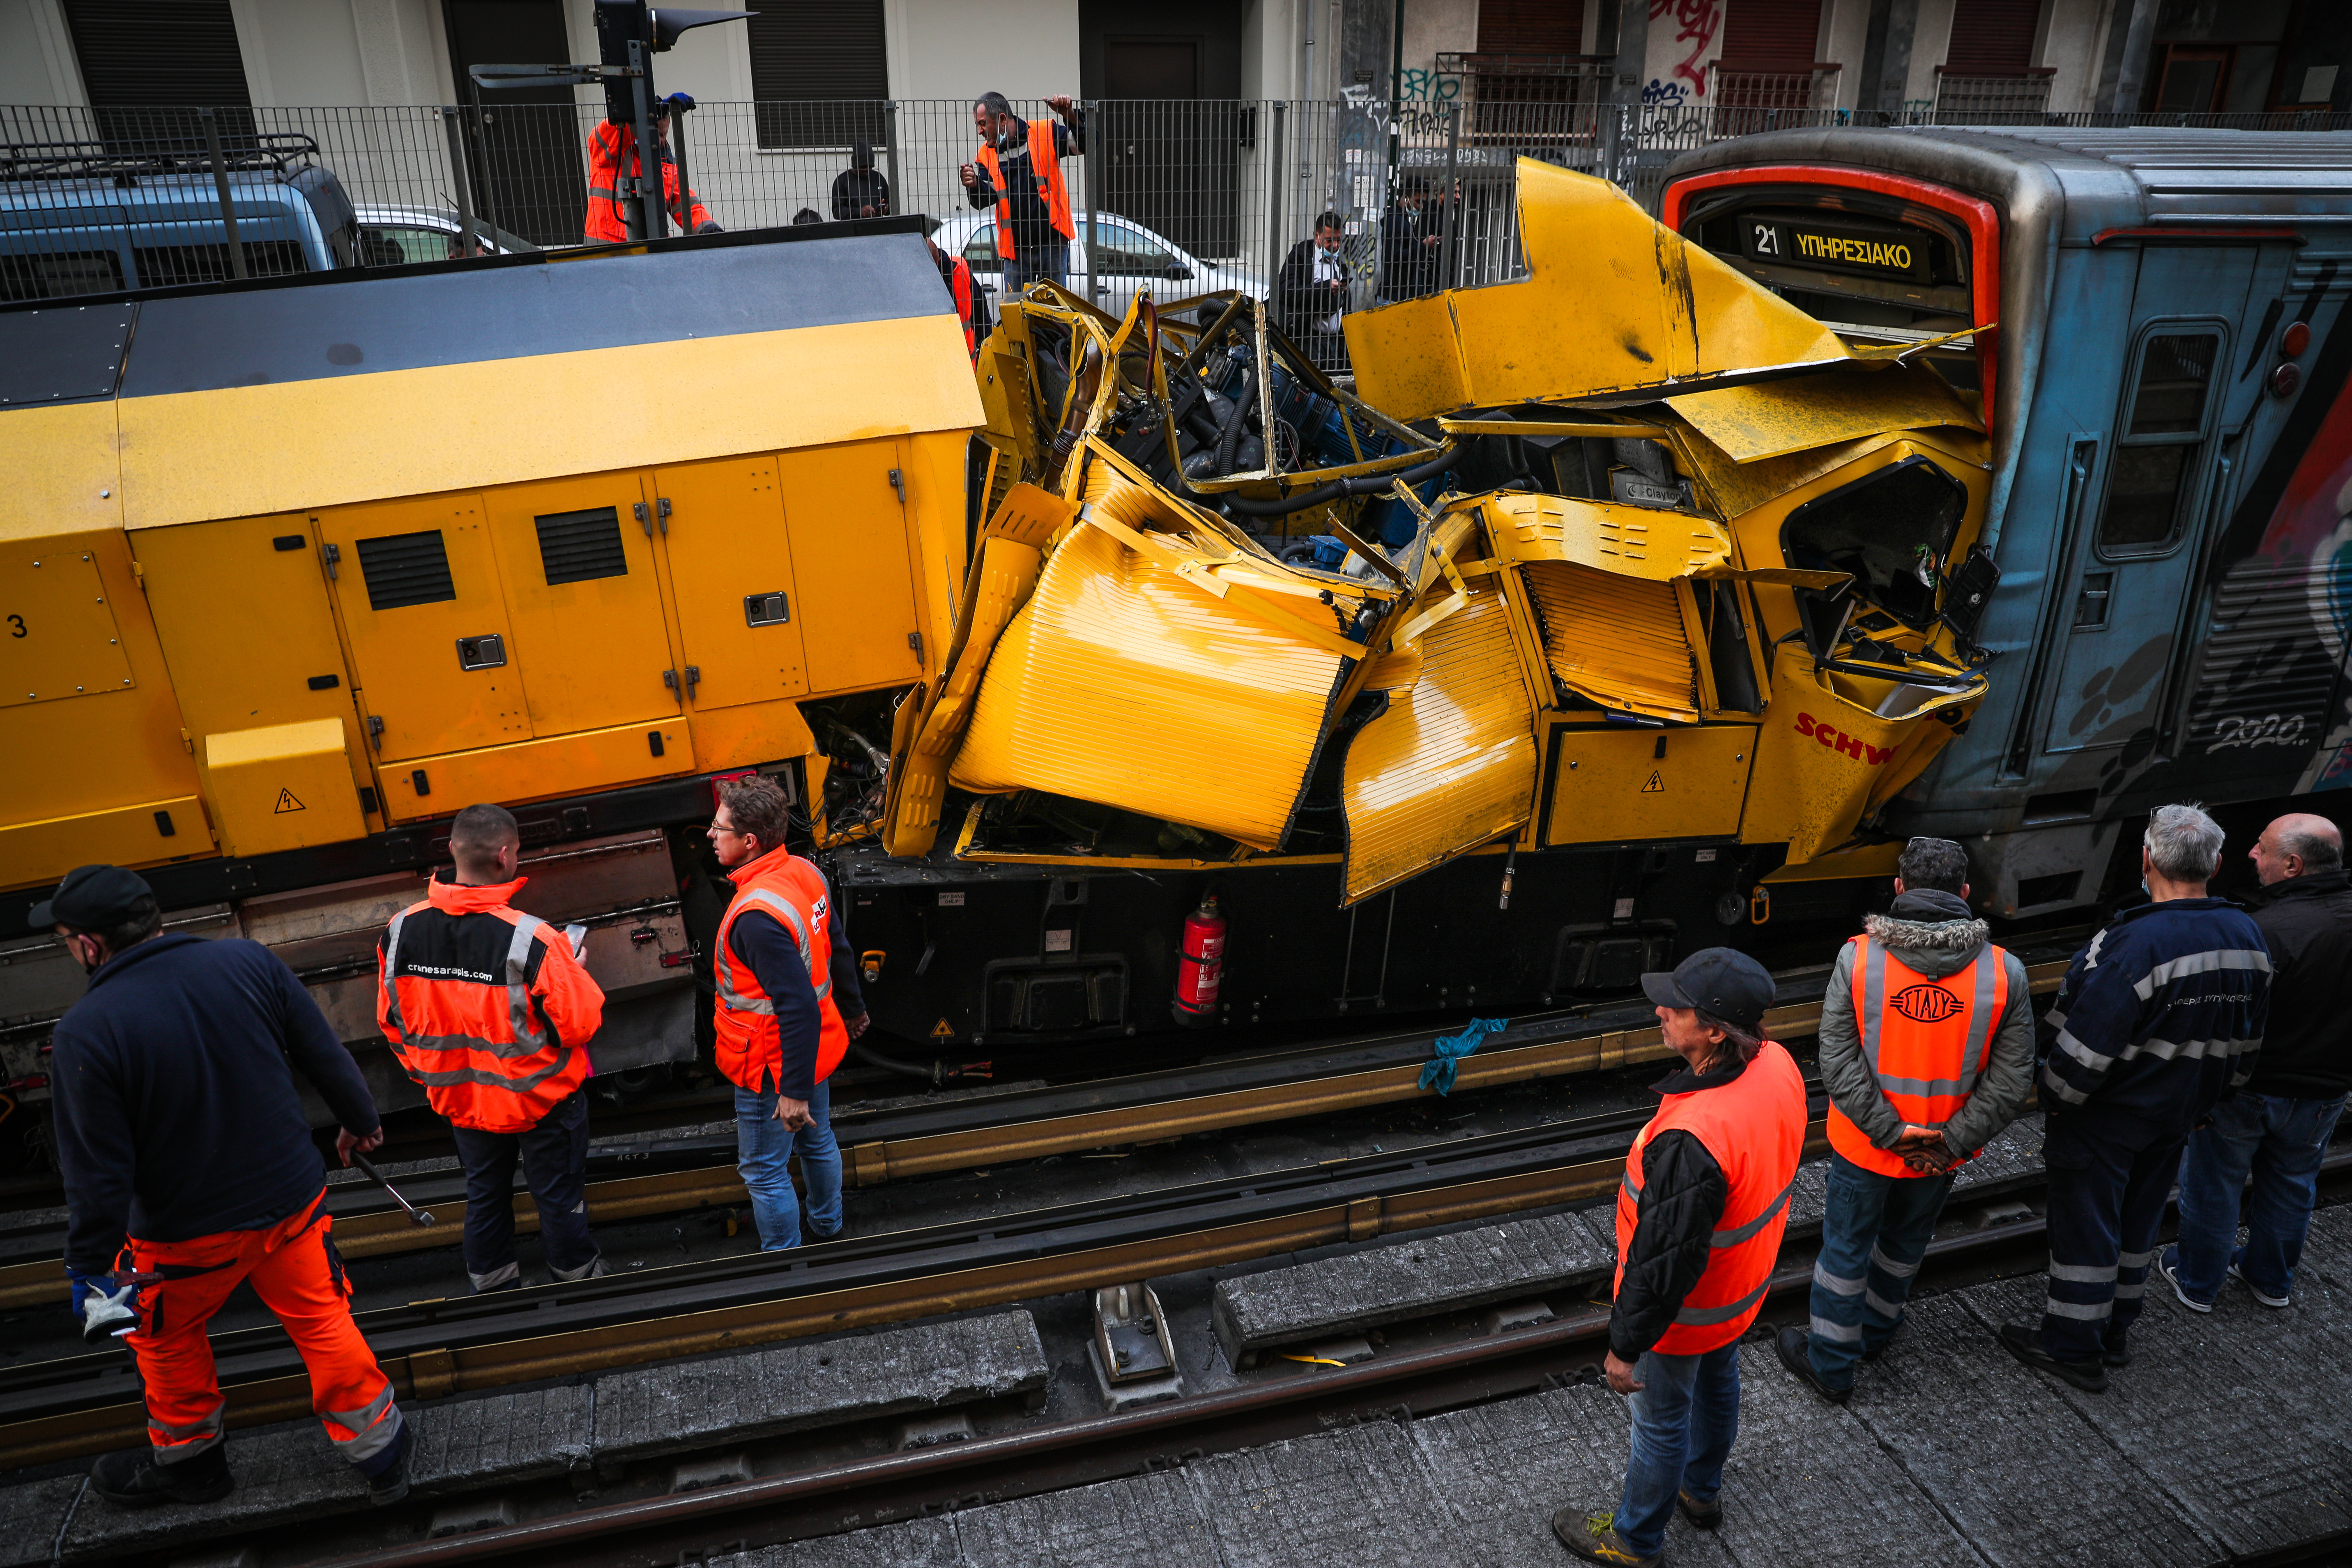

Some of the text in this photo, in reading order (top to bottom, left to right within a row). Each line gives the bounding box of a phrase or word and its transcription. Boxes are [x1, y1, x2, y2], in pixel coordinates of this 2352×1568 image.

[1756, 225, 1911, 269] 21 ΥΠΗΡΕΣΙΑΚΟ
[1646, 488, 1681, 501] Clayton
[7, 614, 28, 638] 3
[408, 964, 492, 981] cranesarapis.com
[1904, 988, 1950, 1019] ΣΤΑΣΥ
